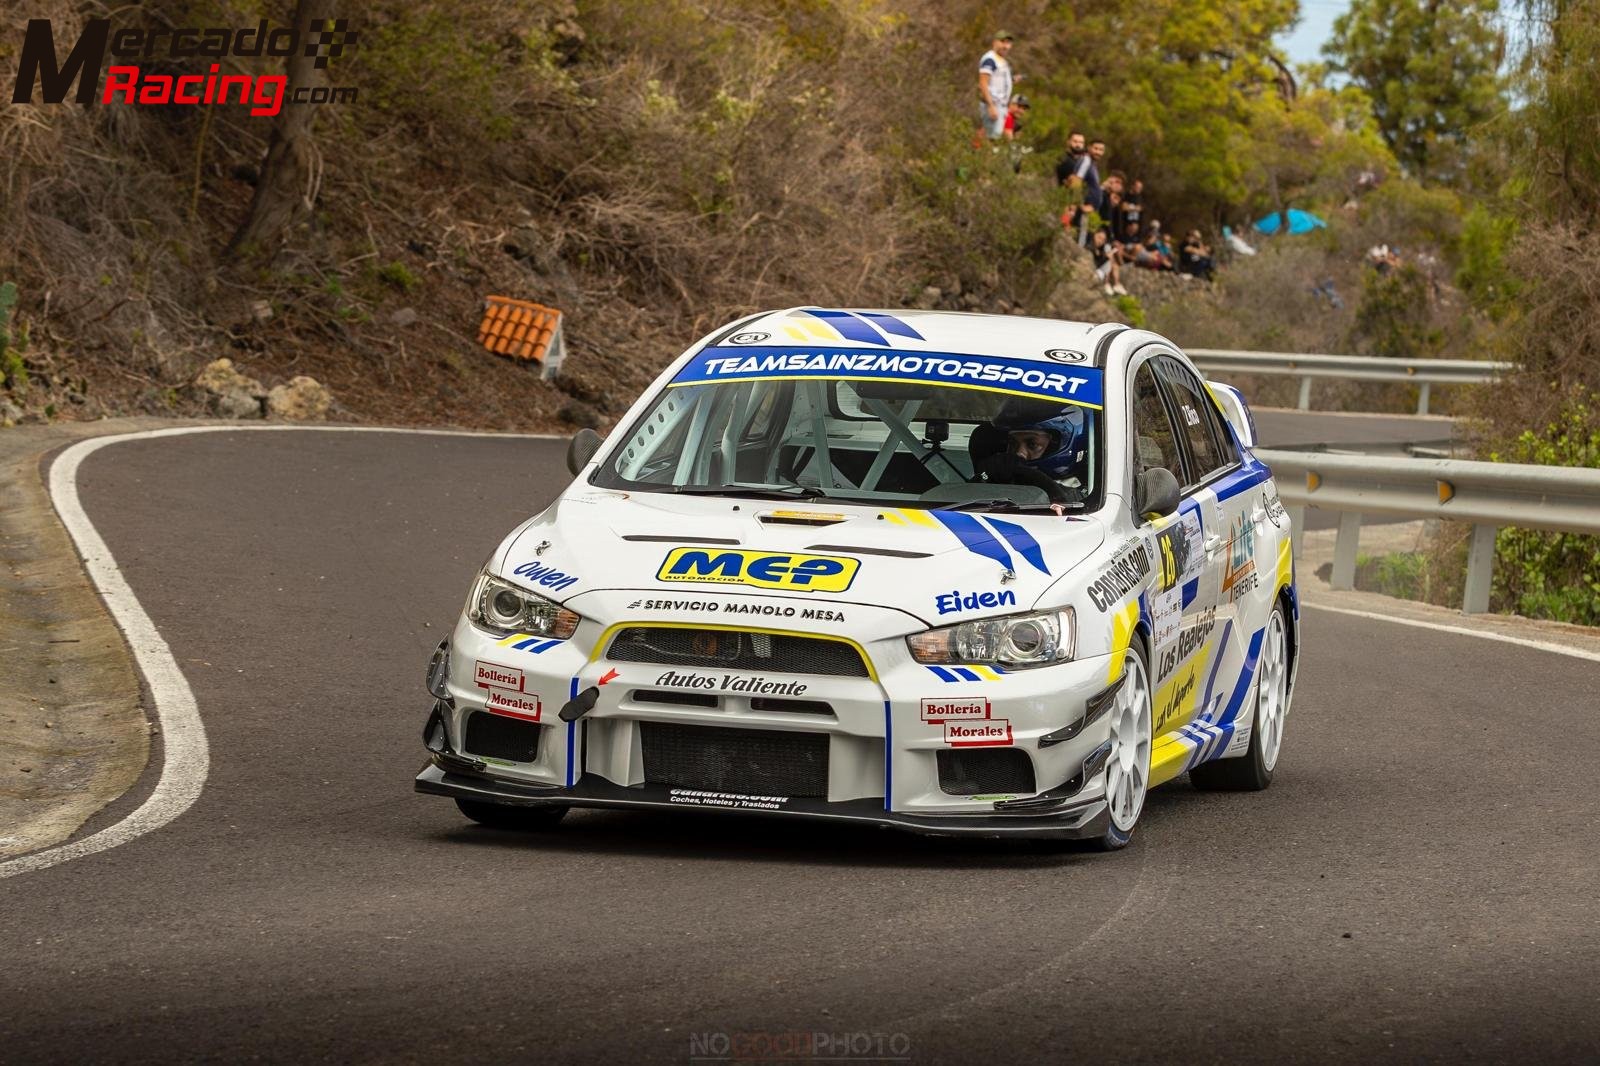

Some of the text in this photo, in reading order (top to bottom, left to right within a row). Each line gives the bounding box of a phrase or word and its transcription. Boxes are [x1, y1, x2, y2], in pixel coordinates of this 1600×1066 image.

[705, 353, 1089, 395] TEAMSAINZMOTORSPORT
[1233, 573, 1259, 600] TENERIFE
[643, 600, 846, 622] SERVICIO MANOLO MESA
[935, 590, 1016, 616] Eiden
[1157, 645, 1176, 683] Los
[1176, 605, 1217, 666] Realejos
[478, 667, 517, 685] Bollería
[655, 670, 808, 696] Autos Valiente
[491, 692, 534, 711] Morales
[926, 702, 982, 716] Bollería
[949, 726, 1004, 738] Morales
[670, 796, 780, 810] Coches, Hoteles y Traslados
